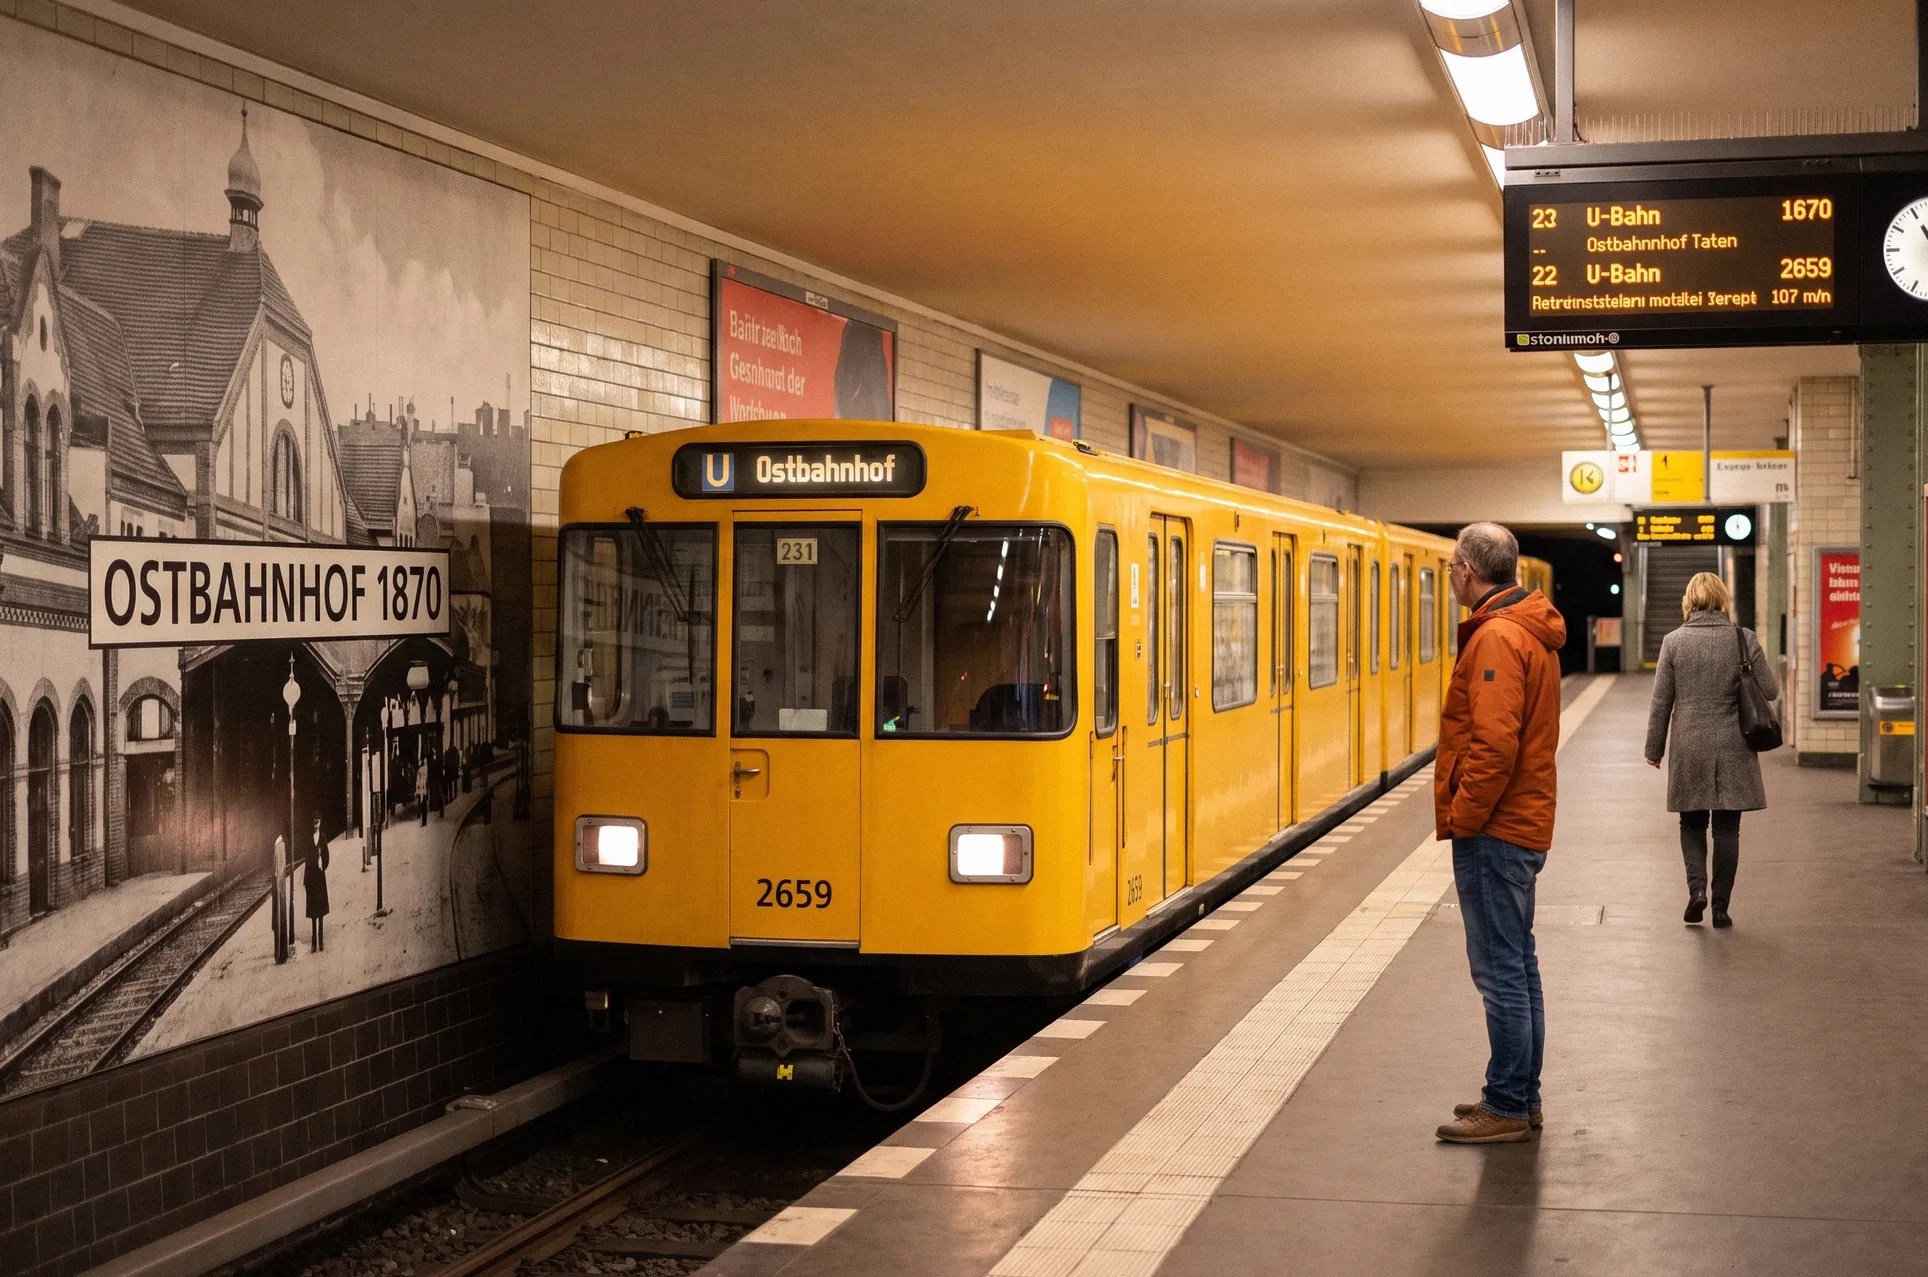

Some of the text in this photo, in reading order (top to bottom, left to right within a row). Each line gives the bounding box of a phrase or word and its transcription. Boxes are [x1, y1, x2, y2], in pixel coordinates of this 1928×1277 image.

[1532, 198, 1832, 229] 23 U-Bahn 1670
[1692, 233, 1738, 249] Taten
[1532, 257, 1832, 286] 22 U-Bahn 2659
[1771, 288, 1798, 304] 107
[787, 366, 806, 397] der
[706, 454, 730, 487] U
[756, 454, 896, 484] Ostbahnhof
[781, 541, 813, 561] 231
[104, 558, 442, 627] OSTBAHNHOF 1870
[756, 878, 833, 909] 2659
